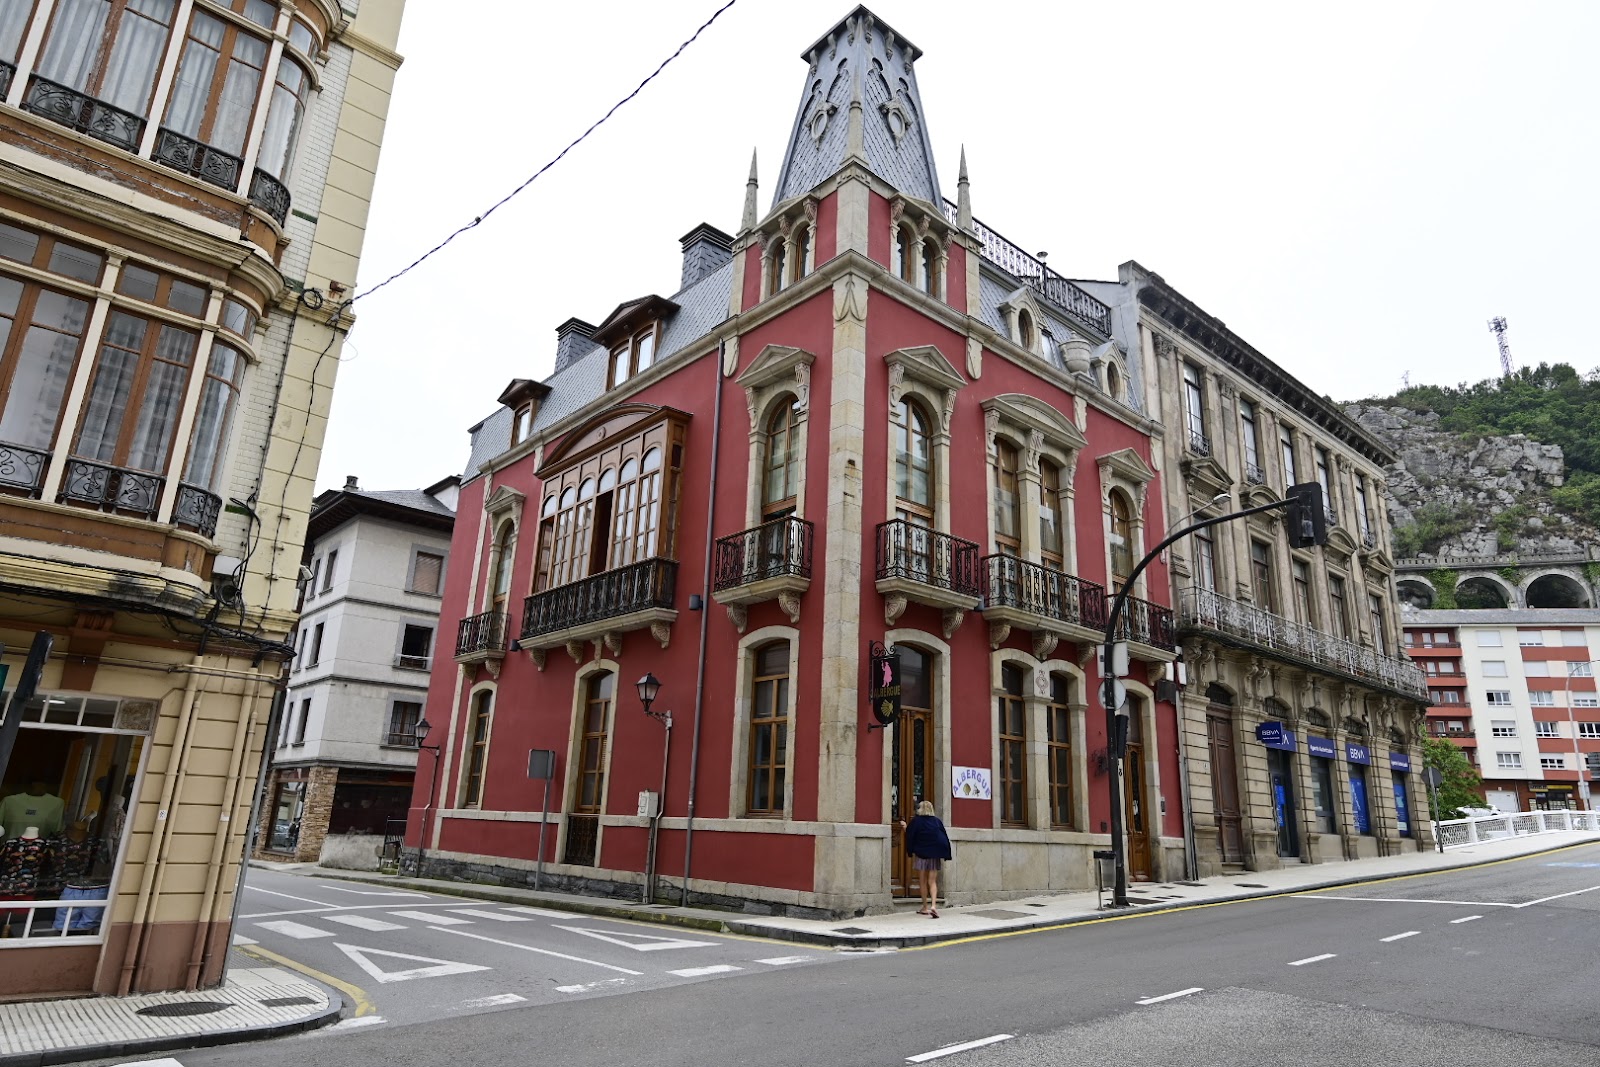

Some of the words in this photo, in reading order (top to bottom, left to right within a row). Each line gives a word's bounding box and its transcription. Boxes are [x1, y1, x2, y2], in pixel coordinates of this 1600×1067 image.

[874, 685, 900, 698] ALBERGUE
[1350, 748, 1366, 759] BBVA
[953, 769, 991, 798] ALBERGUE
